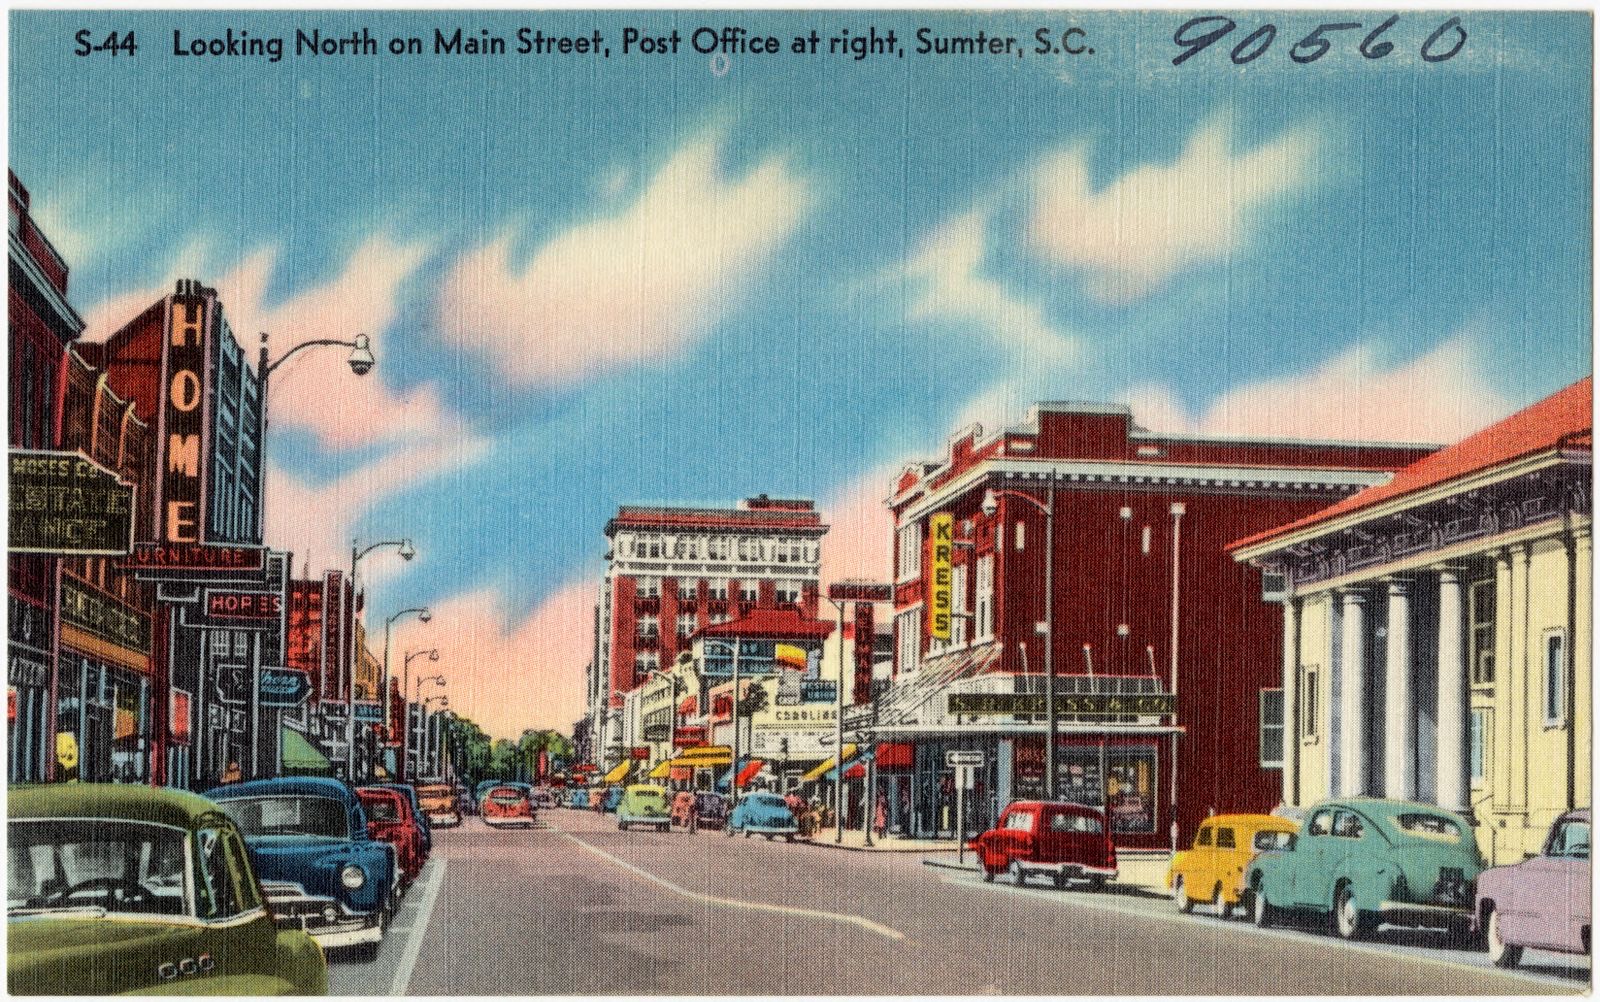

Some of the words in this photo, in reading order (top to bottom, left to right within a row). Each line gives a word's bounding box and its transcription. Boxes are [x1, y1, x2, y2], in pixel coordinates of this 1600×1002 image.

[1171, 15, 1467, 65] 90560
[166, 302, 203, 543] HOME
[934, 521, 951, 632] KRESS
